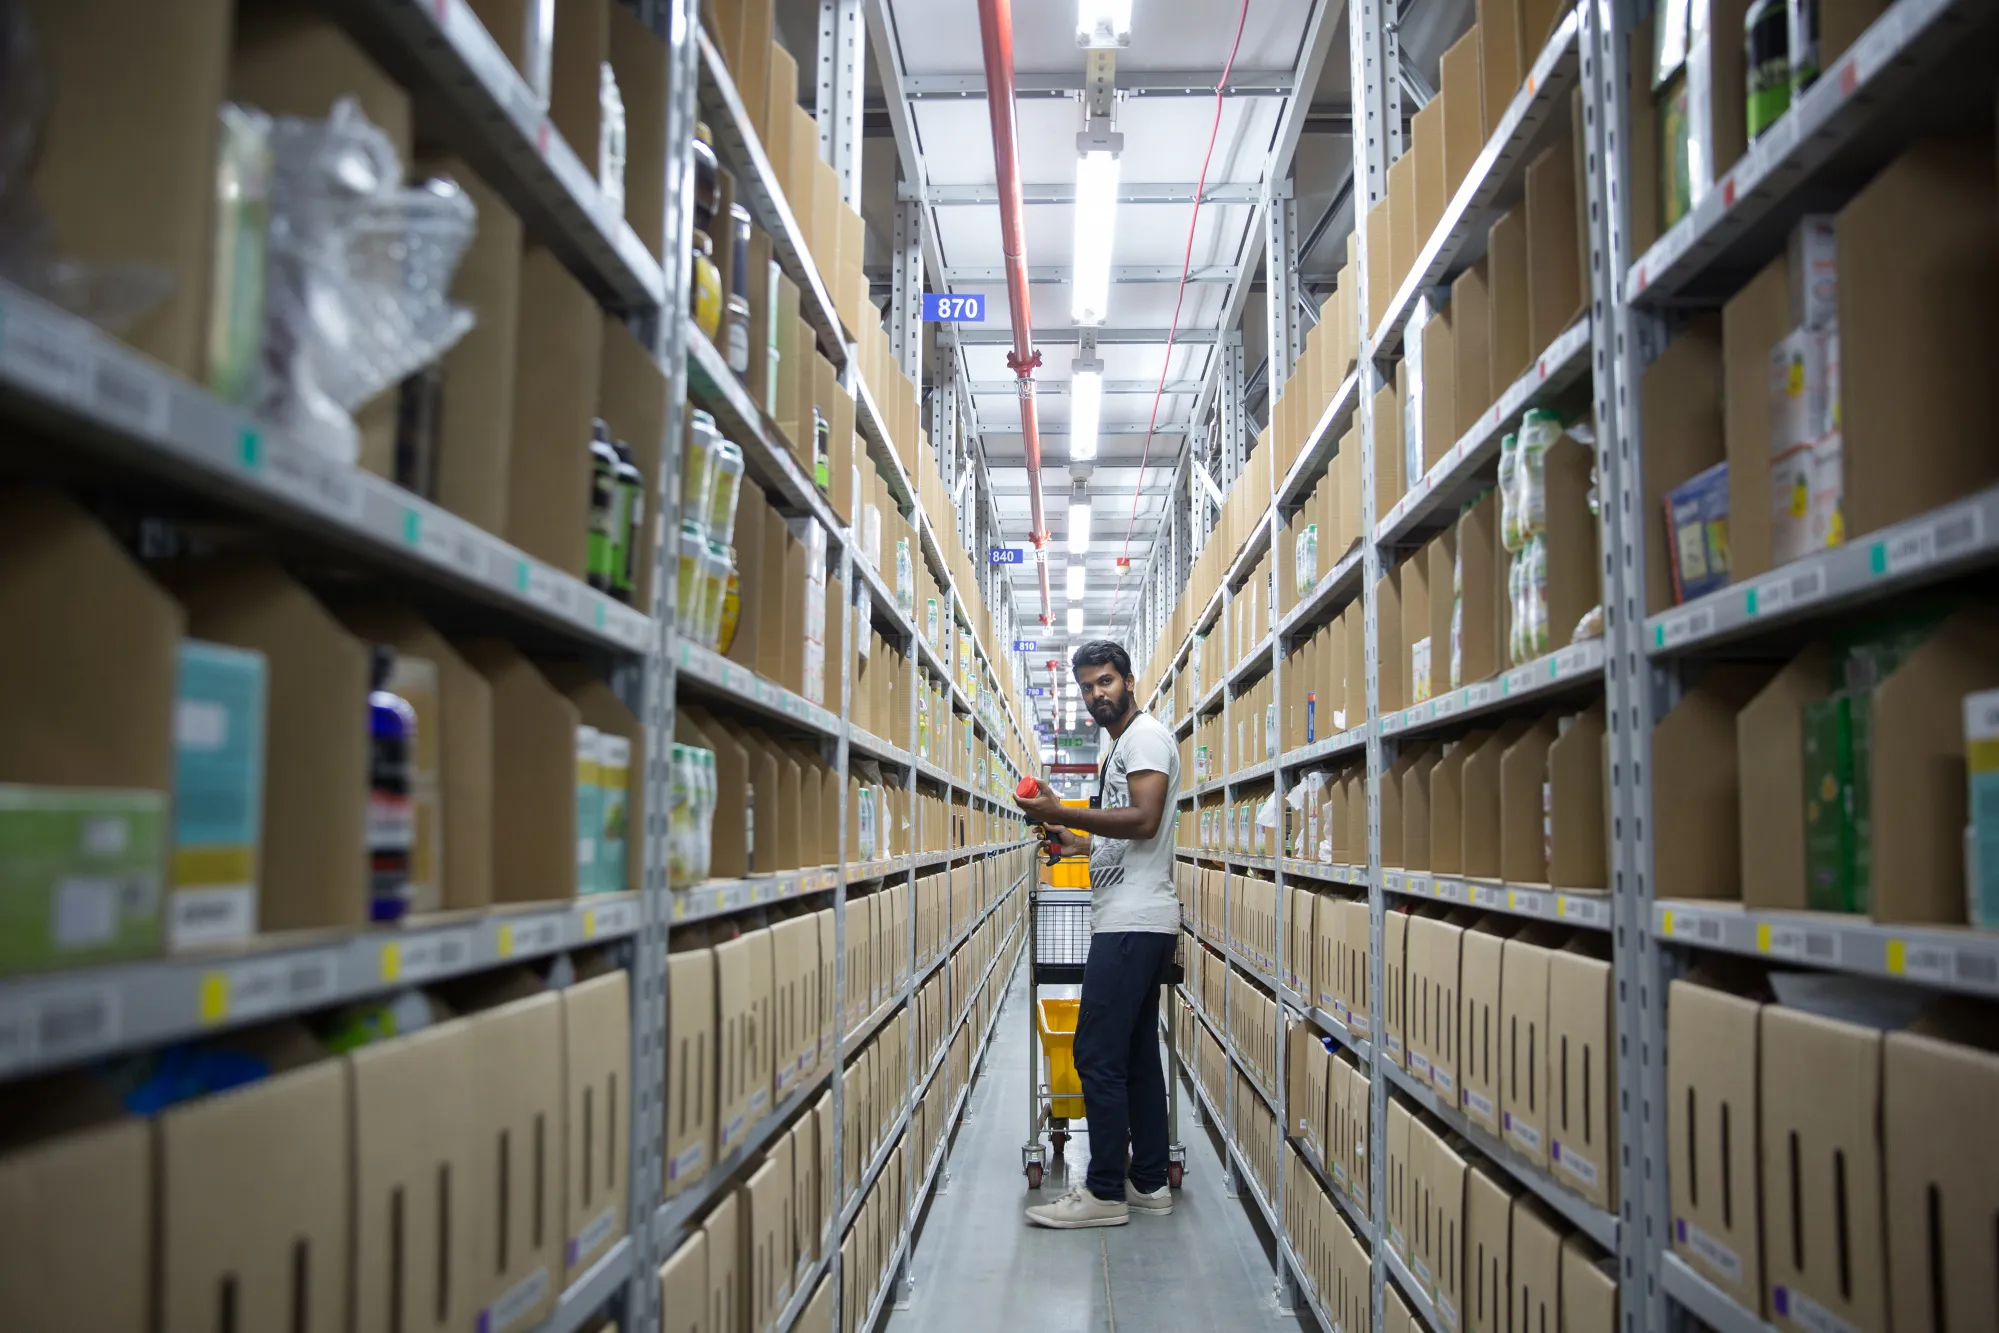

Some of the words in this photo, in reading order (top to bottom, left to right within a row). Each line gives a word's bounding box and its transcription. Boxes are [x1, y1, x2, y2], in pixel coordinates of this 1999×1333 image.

[938, 298, 978, 318] 870
[993, 551, 1014, 562] 840
[1019, 642, 1035, 650] 810
